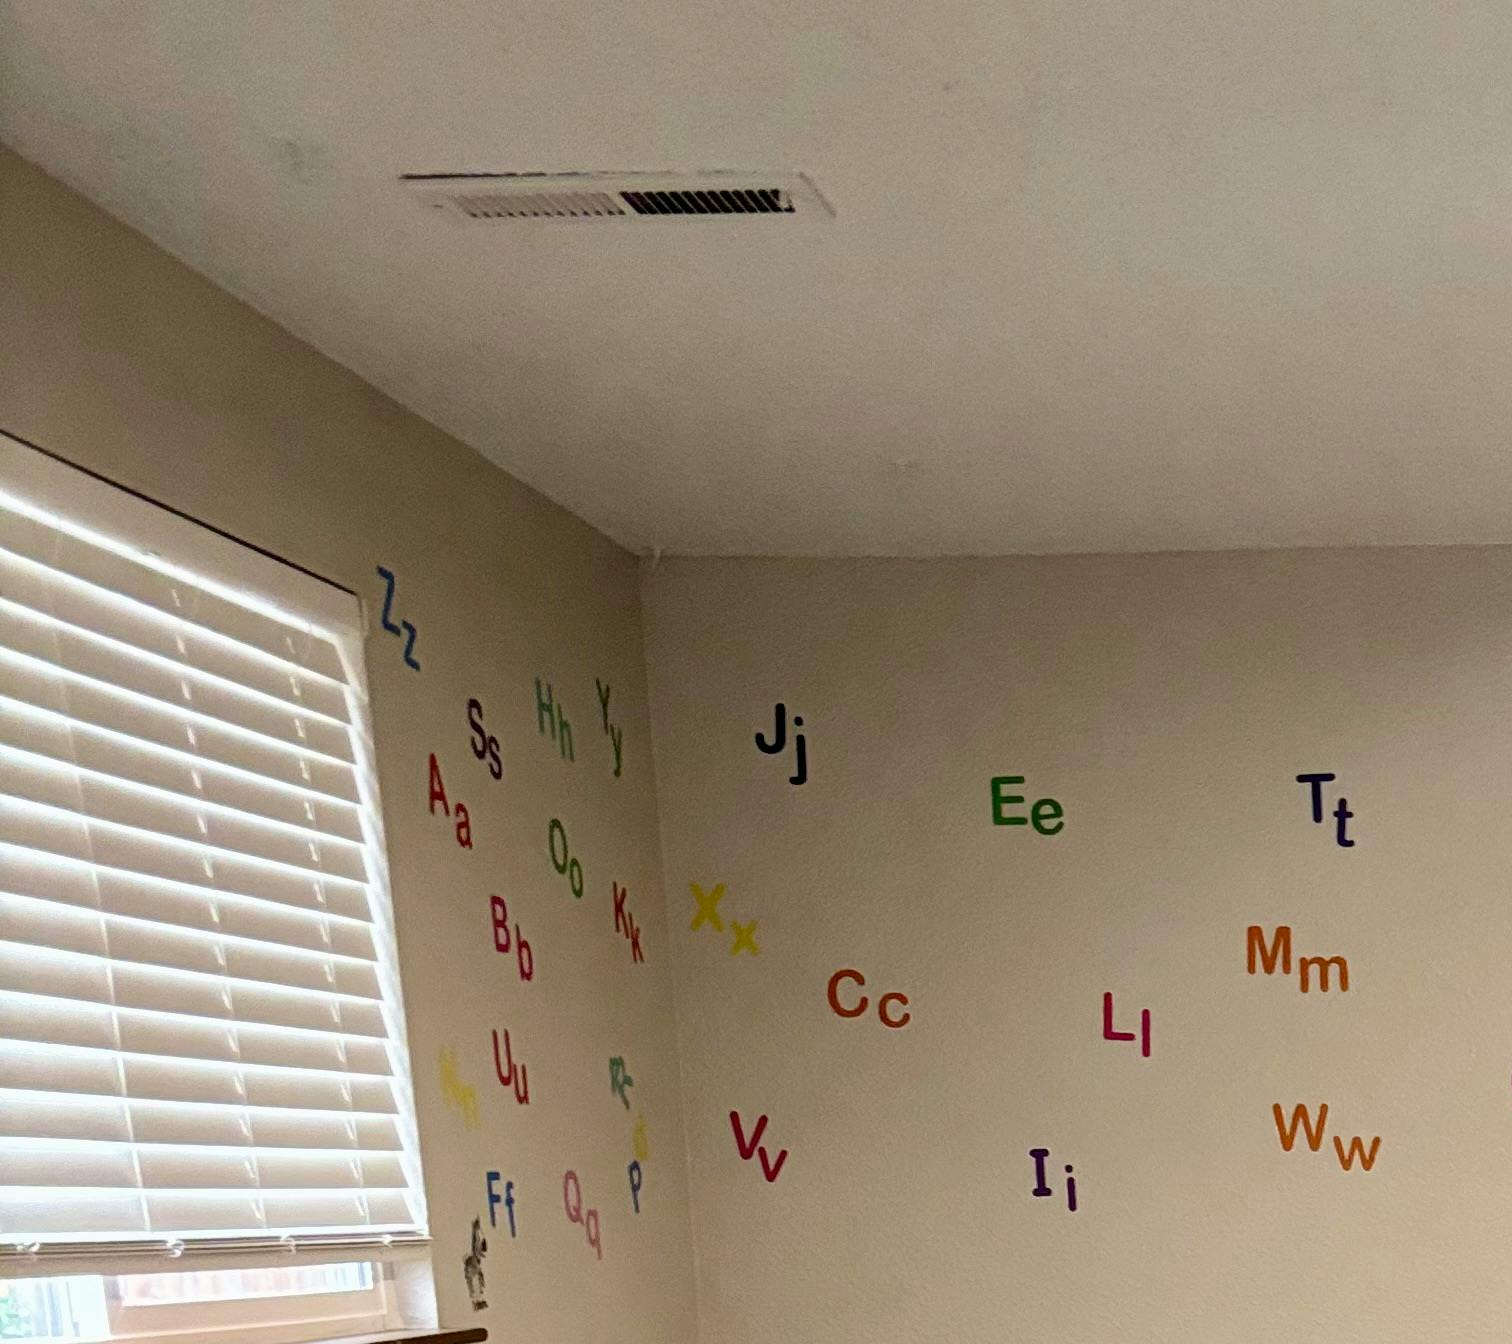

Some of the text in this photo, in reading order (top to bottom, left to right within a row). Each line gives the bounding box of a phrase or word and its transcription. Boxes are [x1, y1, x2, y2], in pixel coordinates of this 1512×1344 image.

[377, 565, 420, 671] Zz
[467, 698, 502, 780] Ss
[535, 676, 575, 762] Hh
[596, 678, 623, 777] Yy
[755, 703, 807, 784] Jj
[429, 752, 472, 850] Aa
[991, 775, 1065, 835] Ee
[1296, 773, 1355, 847] Tt
[550, 818, 583, 898] Oo
[490, 895, 533, 981] Bb
[613, 881, 644, 963] Kk
[689, 882, 761, 956] Xx
[1246, 925, 1348, 993] Mm
[827, 968, 910, 1028] Cc
[1102, 992, 1150, 1057] Ll
[492, 1028, 529, 1104] Uu
[729, 1110, 788, 1182] Vv
[1273, 1103, 1381, 1170] Ww
[486, 1172, 516, 1238] Ff
[564, 1170, 603, 1260] Qq
[1029, 1148, 1078, 1211] Ii
